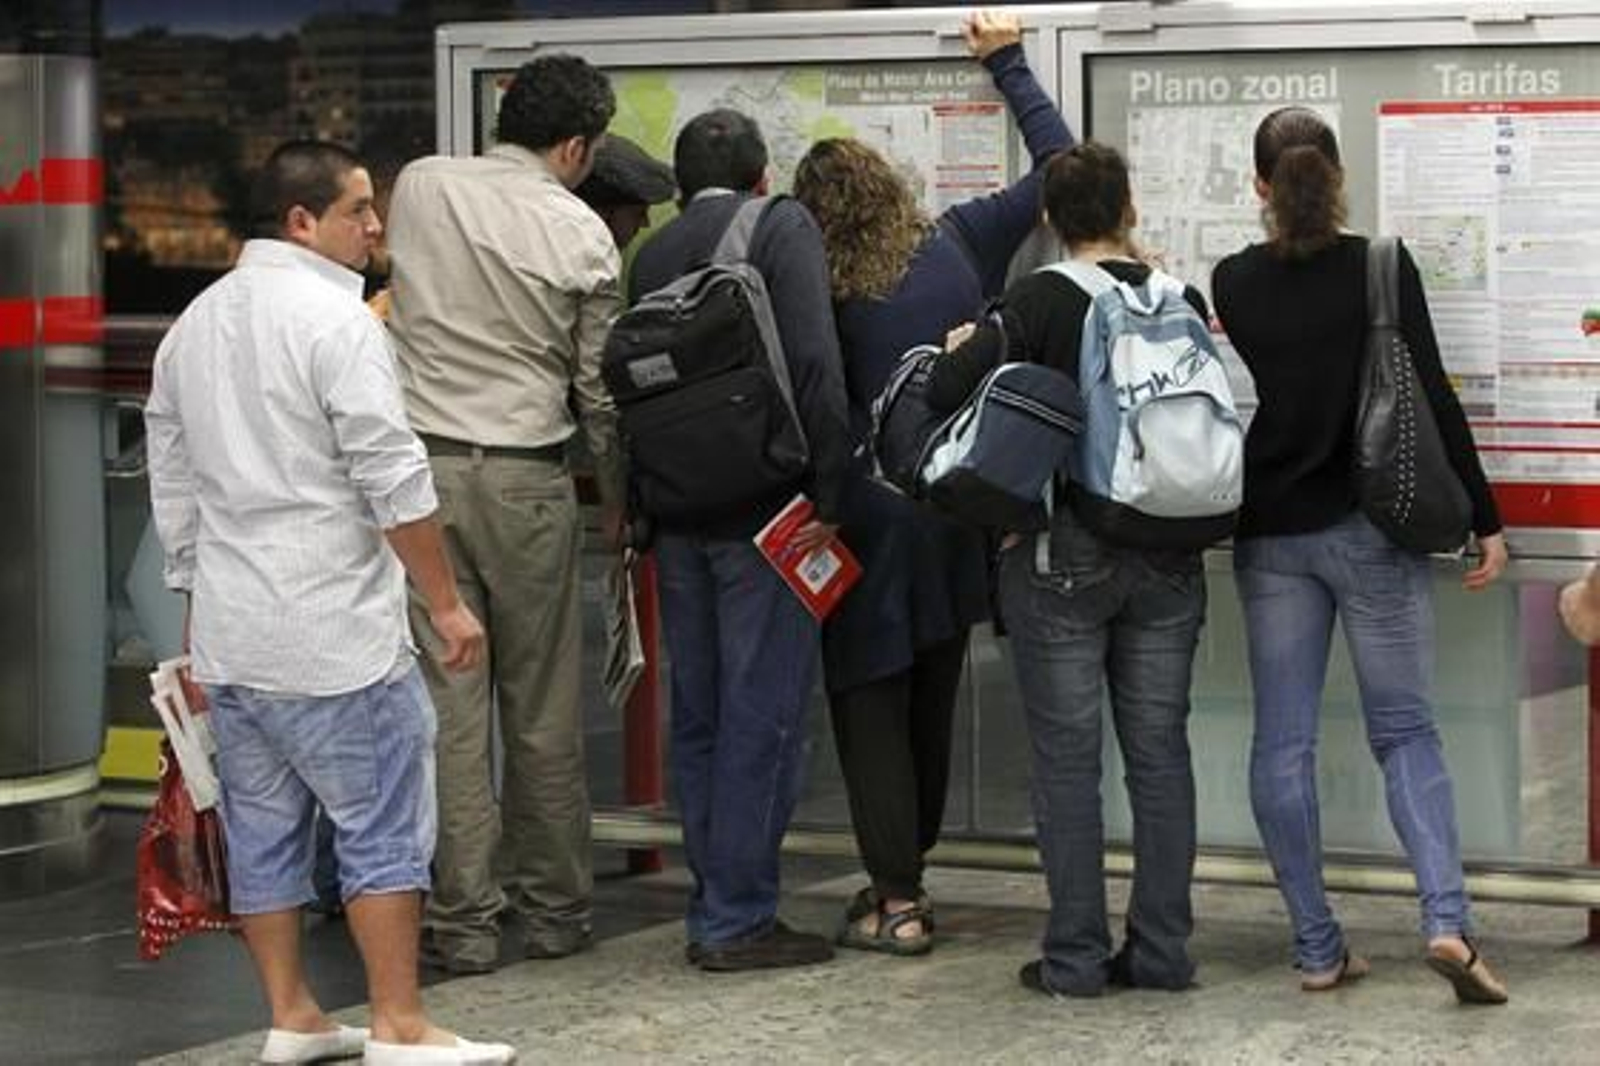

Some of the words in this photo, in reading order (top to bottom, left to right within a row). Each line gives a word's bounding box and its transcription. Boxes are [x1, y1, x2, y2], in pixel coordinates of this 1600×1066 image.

[1130, 70, 1230, 102] Plano
[1241, 66, 1338, 100] zonal
[1433, 62, 1560, 95] Tarifas
